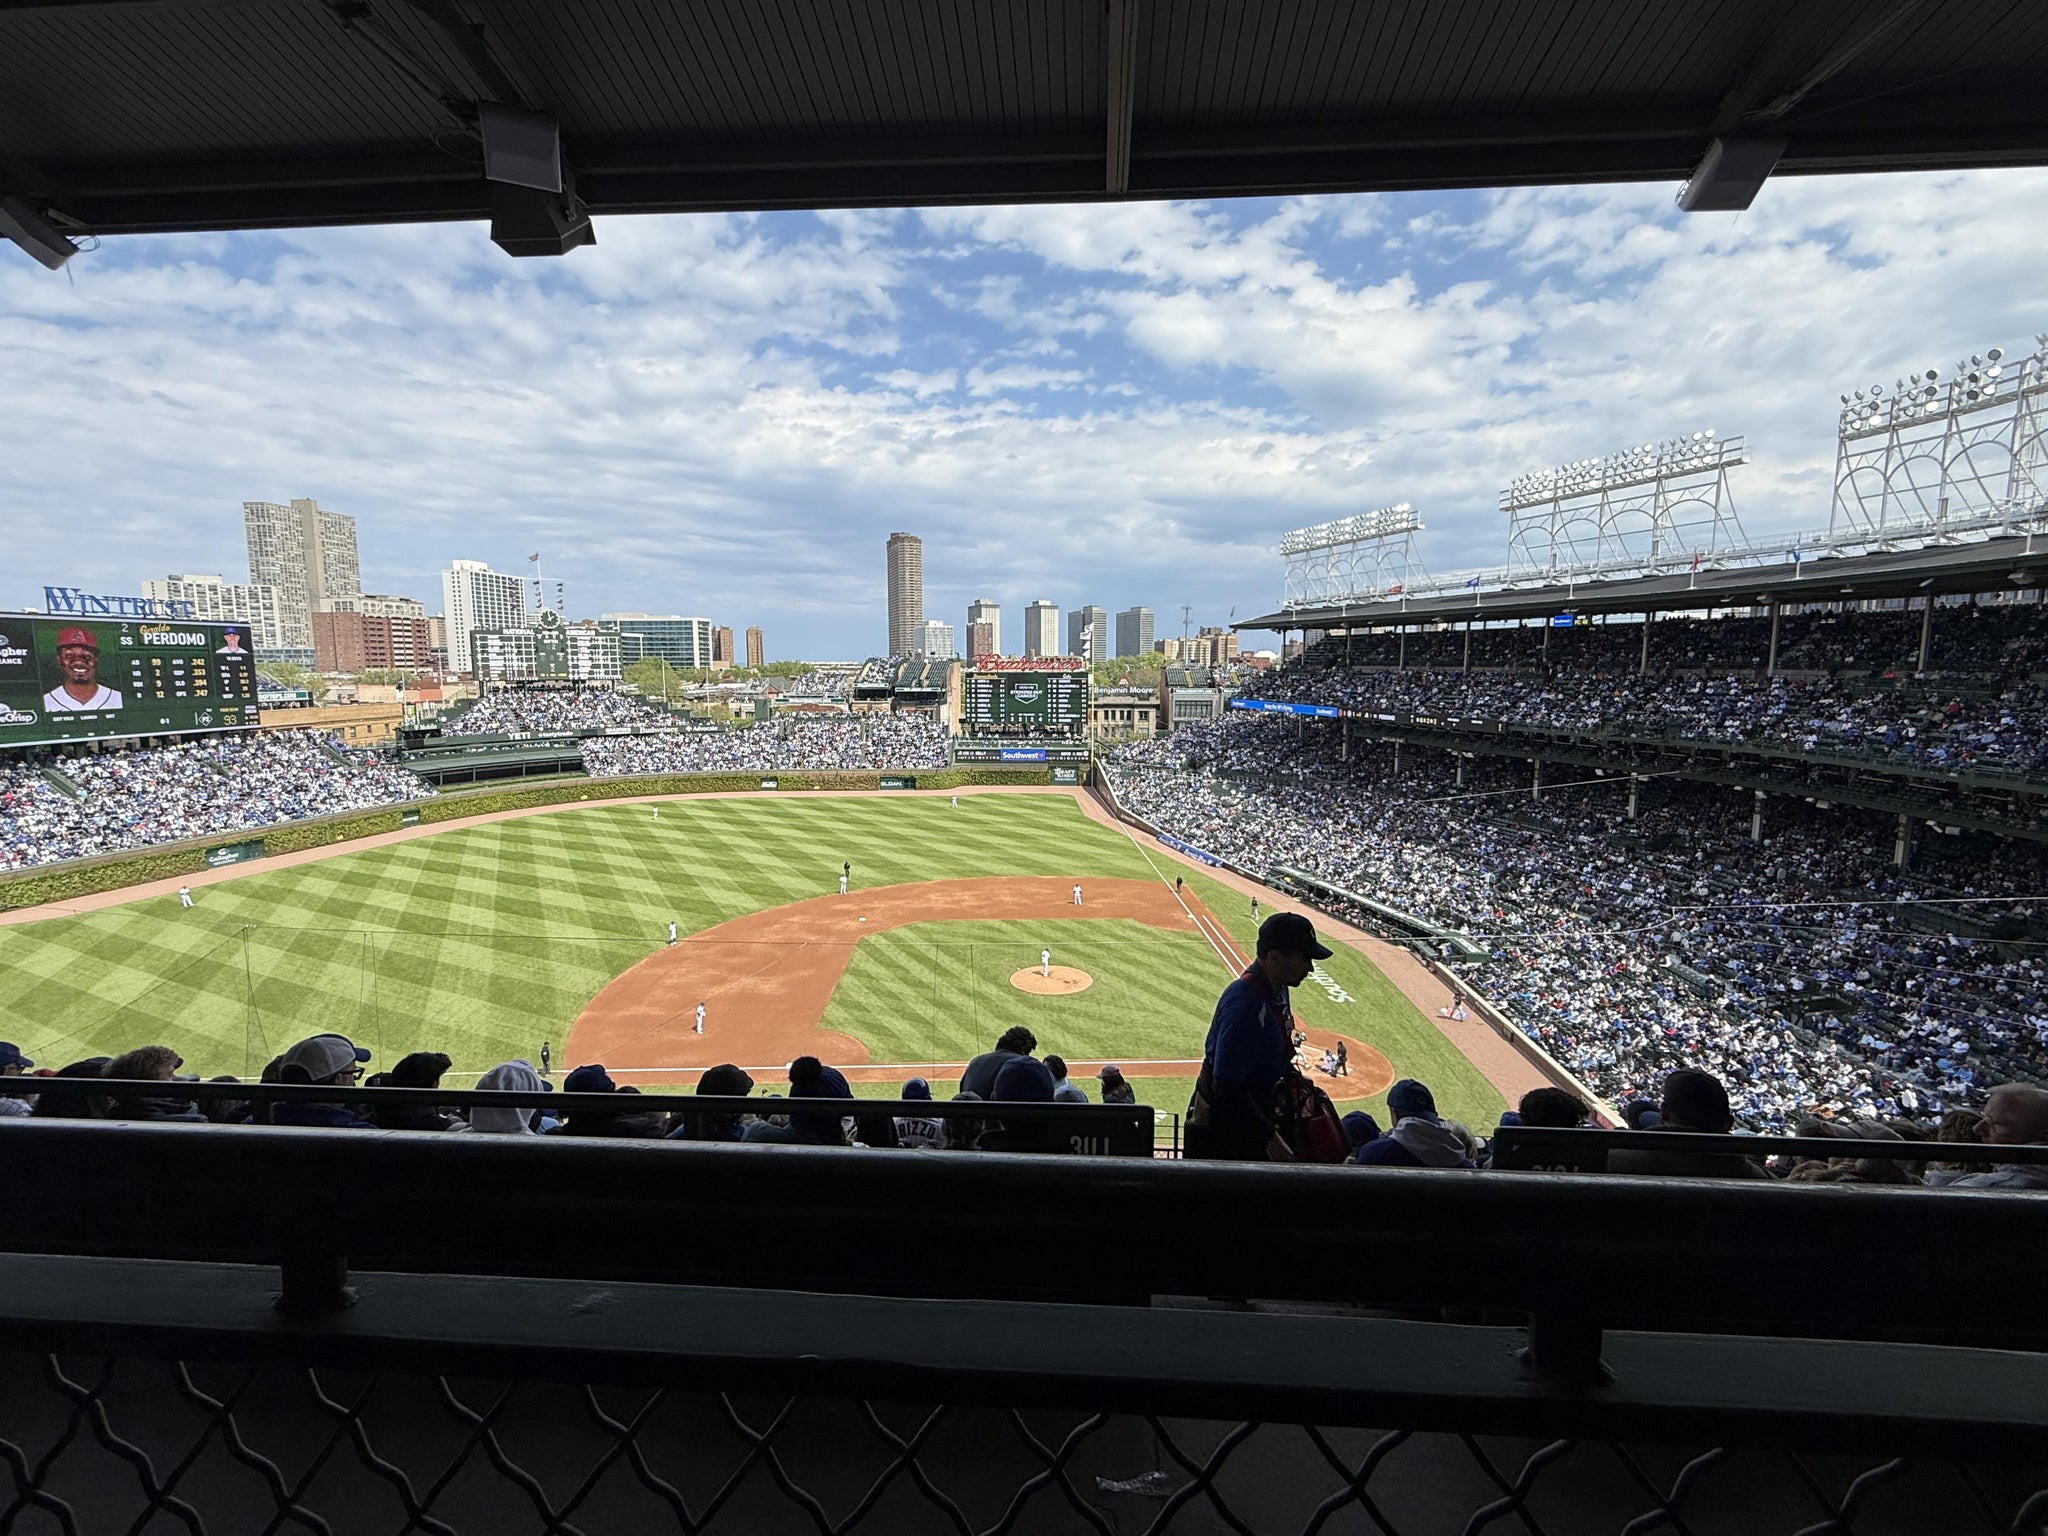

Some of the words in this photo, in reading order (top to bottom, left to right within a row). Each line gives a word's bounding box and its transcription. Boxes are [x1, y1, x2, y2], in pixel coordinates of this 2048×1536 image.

[43, 586, 194, 618] WINTRUST
[121, 623, 129, 633] 2
[140, 624, 170, 634] Geraldo
[503, 628, 534, 636] NATIONAL
[120, 636, 133, 645] SS
[143, 632, 206, 646] PERDOMO
[0, 646, 28, 658] gher
[0, 657, 23, 665] ANCE
[972, 653, 1082, 672] Budweiser
[1094, 686, 1129, 695] Benjamin
[1129, 686, 1154, 694] Moore
[223, 714, 238, 725] 93
[507, 732, 531, 740] YETI
[1002, 751, 1039, 759] Southwest
[897, 1120, 936, 1140] RIZZO
